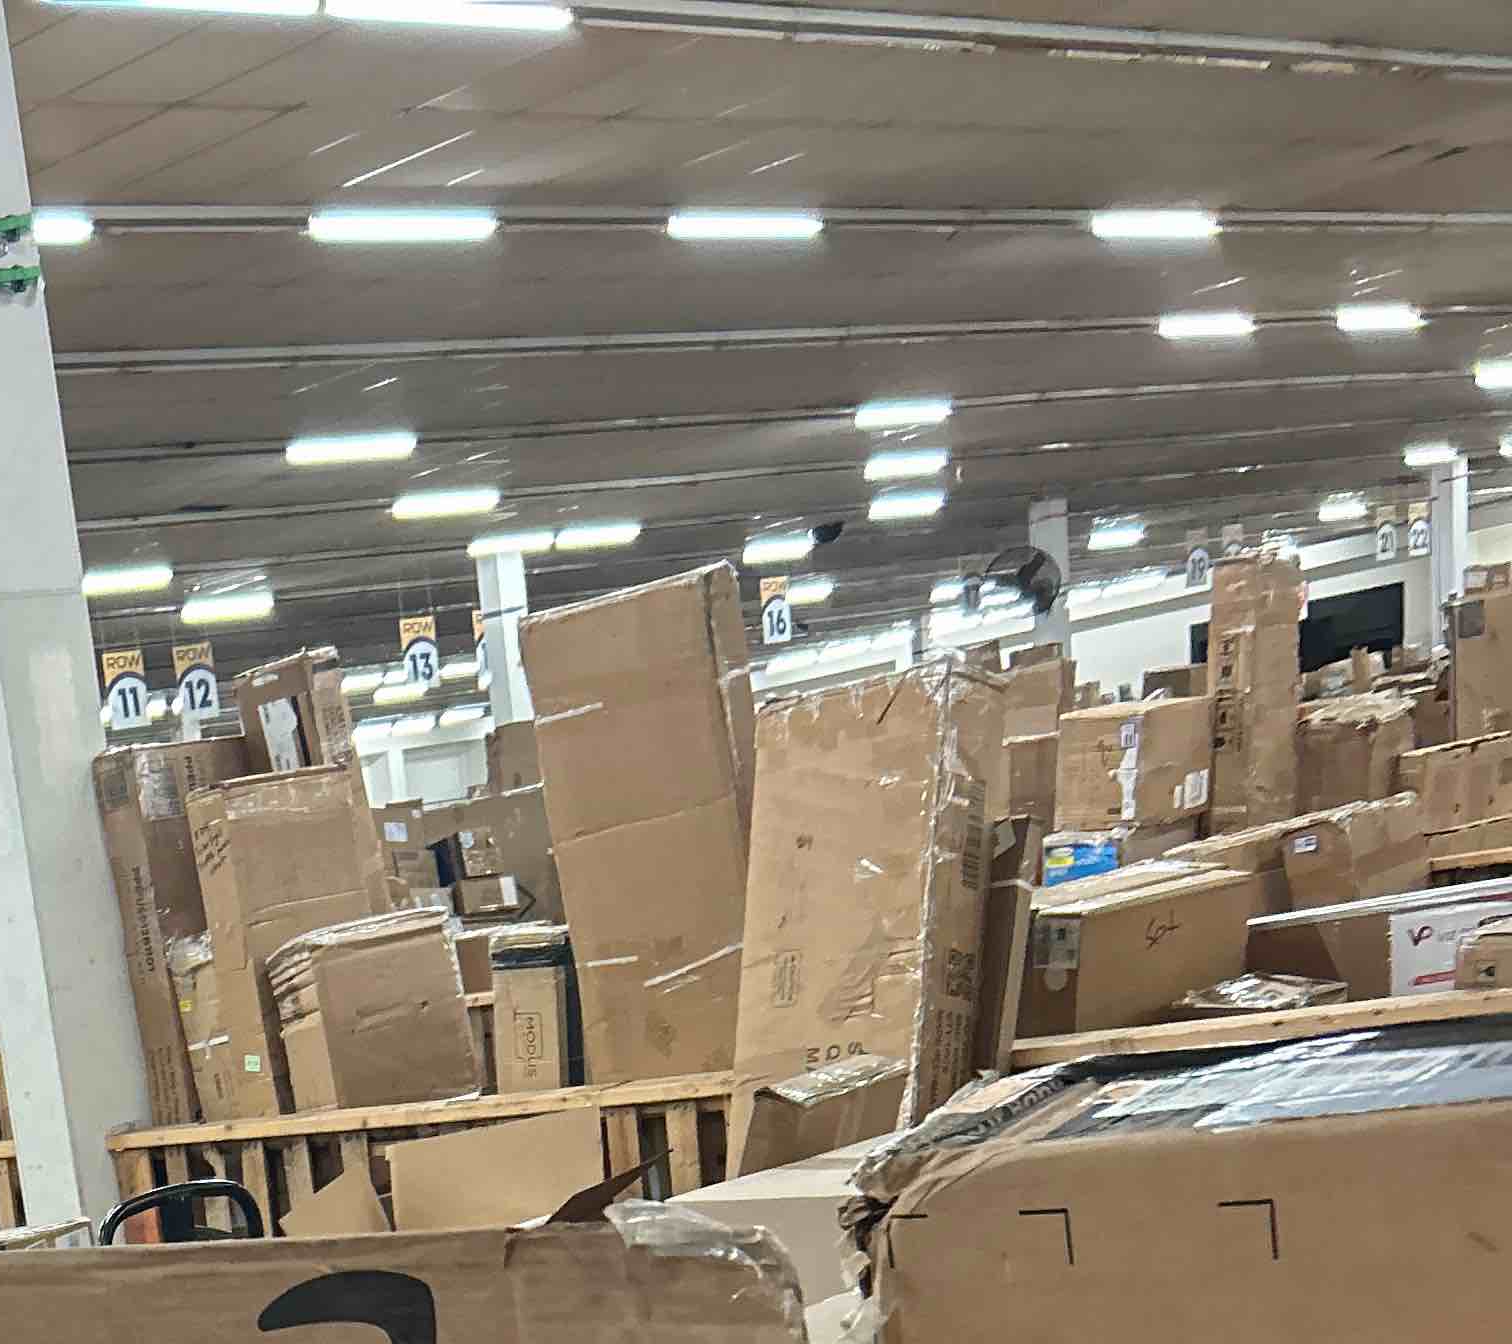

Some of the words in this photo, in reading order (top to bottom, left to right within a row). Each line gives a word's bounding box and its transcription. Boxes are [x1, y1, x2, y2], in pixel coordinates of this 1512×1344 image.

[768, 609, 787, 637] 16
[105, 655, 141, 670] ROW
[409, 653, 433, 681] 13
[117, 686, 140, 719] 11
[185, 678, 212, 710] 12
